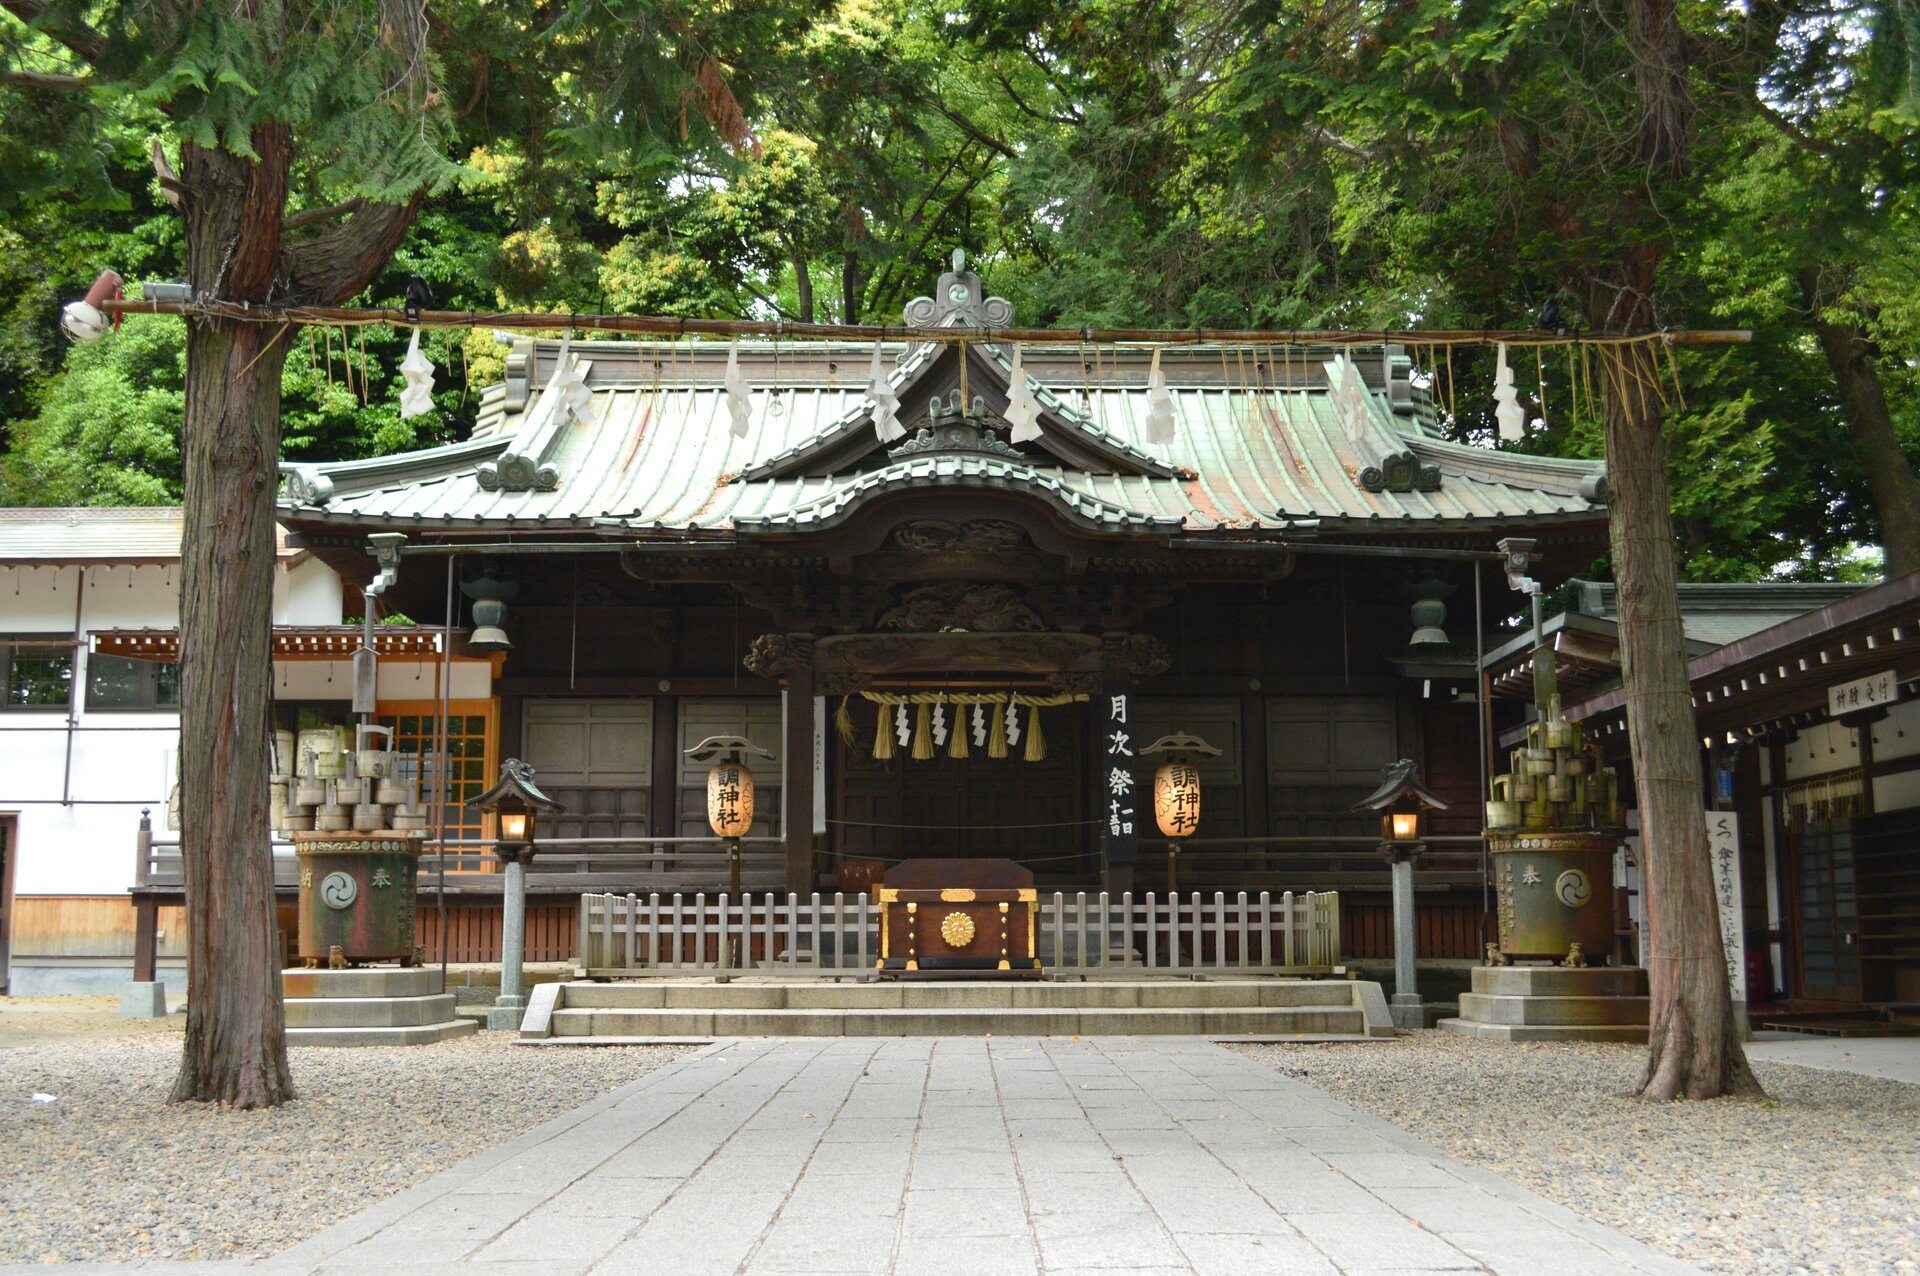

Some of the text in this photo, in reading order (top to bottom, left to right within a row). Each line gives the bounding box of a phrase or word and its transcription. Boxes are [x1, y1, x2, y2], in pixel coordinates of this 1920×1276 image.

[1108, 694, 1134, 796] 月次祭
[717, 769, 740, 829] 調神社
[1170, 767, 1199, 833] 調神社
[1109, 800, 1120, 836] 十五日
[1121, 808, 1133, 834] 一日
[371, 868, 392, 888] 奉
[1522, 864, 1541, 886] 奉
